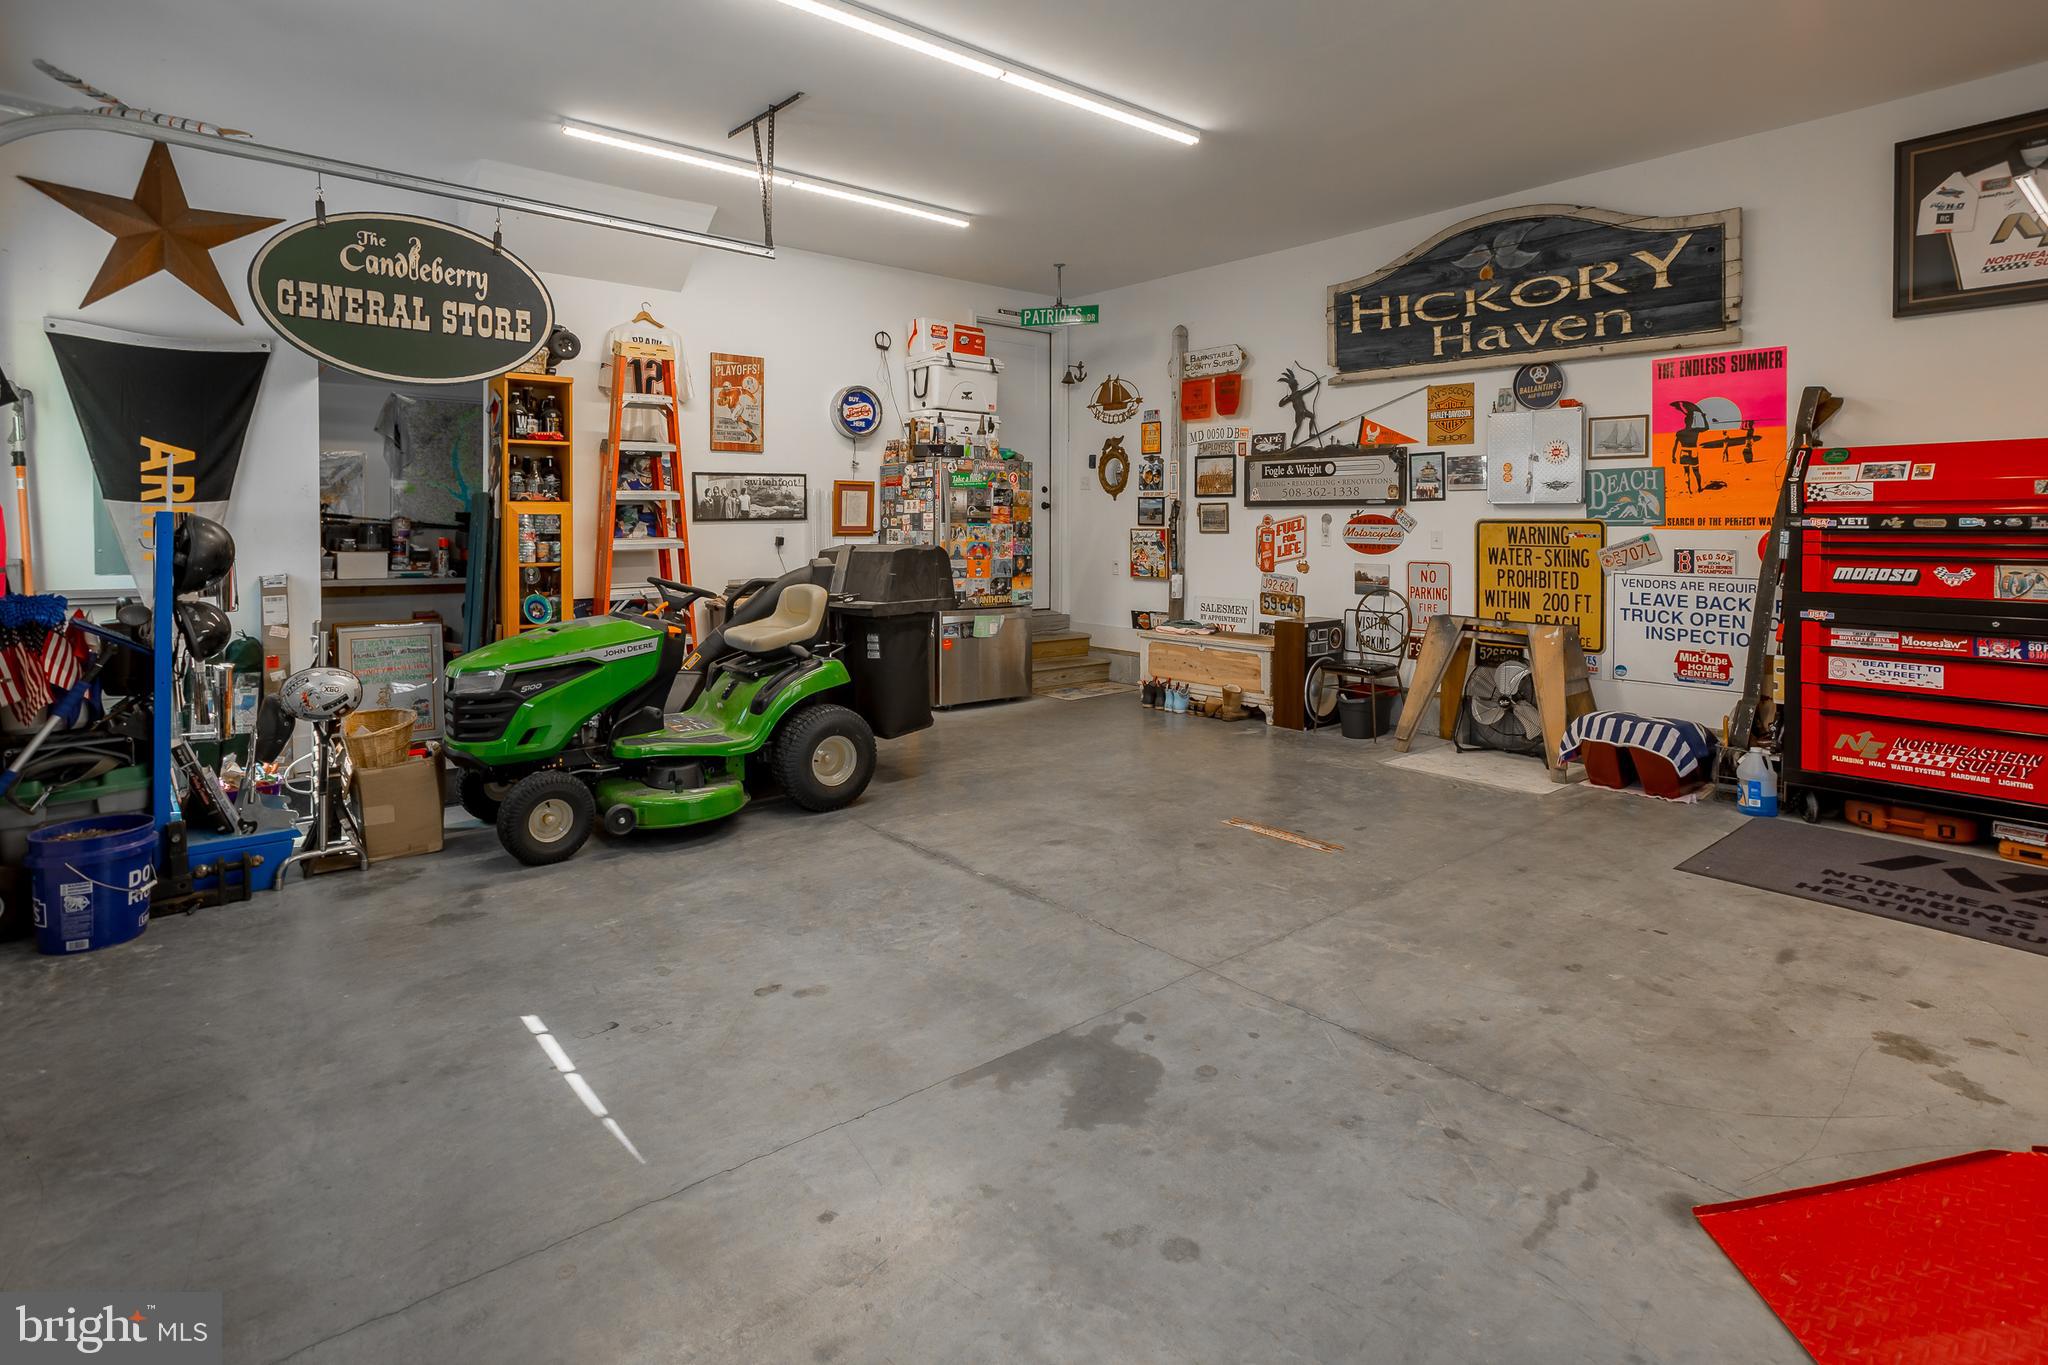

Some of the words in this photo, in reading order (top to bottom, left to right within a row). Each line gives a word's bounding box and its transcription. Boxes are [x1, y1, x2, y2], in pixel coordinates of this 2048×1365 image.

[357, 230, 386, 247] The
[340, 240, 489, 301] Candleberry
[1350, 232, 1695, 335] HICKORY
[277, 278, 430, 332] GENERAL
[442, 299, 532, 343] STORE
[1023, 308, 1082, 325] PATRIOTS
[1432, 308, 1633, 356] Haven
[1185, 363, 1212, 371] COUNTY
[1213, 358, 1240, 367] SUPPLY
[1190, 351, 1234, 363] BARNSTABLE
[715, 363, 760, 377] PLAYOFFS!
[1657, 362, 1676, 380] THE
[1680, 356, 1726, 377] ENDLESS
[1730, 351, 1783, 372] SUMMER
[1520, 380, 1562, 395] BALLANTINE'S
[1190, 430, 1204, 443] MD
[1206, 427, 1225, 440] 0050
[1264, 466, 1286, 477] Fogle
[1287, 467, 1294, 475] &
[1295, 464, 1322, 476] Wright
[744, 477, 798, 488] switchfoot
[1292, 478, 1336, 487] REMODELING
[1342, 477, 1393, 486] RENOVATIONS
[1282, 486, 1361, 499] 508-362-1338
[1590, 470, 1657, 510] BEACH
[1276, 519, 1304, 536] FUEL
[1667, 518, 1695, 526] SEARCH
[1709, 517, 1722, 525] THE
[1724, 517, 1756, 526] PERFECT
[1839, 517, 1868, 525] YETI
[1282, 533, 1297, 543] FOR
[1344, 527, 1403, 541] Motorcycles
[1507, 526, 1570, 546] WARNING
[1277, 541, 1302, 557] LIFE
[1679, 551, 1692, 573] B
[1695, 553, 1713, 562] RED
[1715, 553, 1733, 562] SOX
[1420, 570, 1436, 584] NO
[1497, 569, 1579, 590] PROHIBITED
[1832, 566, 1919, 583] MOROSO
[1621, 578, 1677, 590] VENDORS
[1680, 580, 1704, 591] ARE
[1410, 586, 1448, 601] PARKING
[1485, 590, 1531, 610] WITHIN
[1542, 593, 1569, 612] 200
[1200, 603, 1248, 615] SALESMEN
[1419, 602, 1438, 613] FIRE
[1630, 591, 1689, 609] LEAVE
[1696, 594, 1752, 613] BACK
[1208, 615, 1248, 624] APPOINTMENT
[1621, 608, 1684, 625] TRUCK
[1689, 611, 1746, 630] OPEN
[604, 648, 625, 657] JOHN
[627, 642, 653, 654] DEERE
[2028, 643, 2042, 652] 60
[1679, 652, 1728, 666] Mid-Cape
[1681, 669, 1727, 680] CENTERS
[1688, 663, 1719, 672] HOME
[1894, 662, 1921, 671] FEET
[1926, 665, 1942, 673] TO
[520, 682, 543, 694] S100
[1892, 736, 2043, 768] NORTHEASTERN
[1832, 756, 1864, 766] PLUMBING
[1868, 761, 1886, 769] HVAC
[1891, 763, 1913, 773] WATER
[1914, 766, 1946, 777] SYSTEMS
[1951, 772, 1991, 784] HARDWARE
[1998, 778, 2034, 790] LIGHTING
[1957, 760, 2034, 780] SUPPLY
[1795, 881, 1970, 927] HEATING
[1821, 878, 2036, 931] PLUMBING
